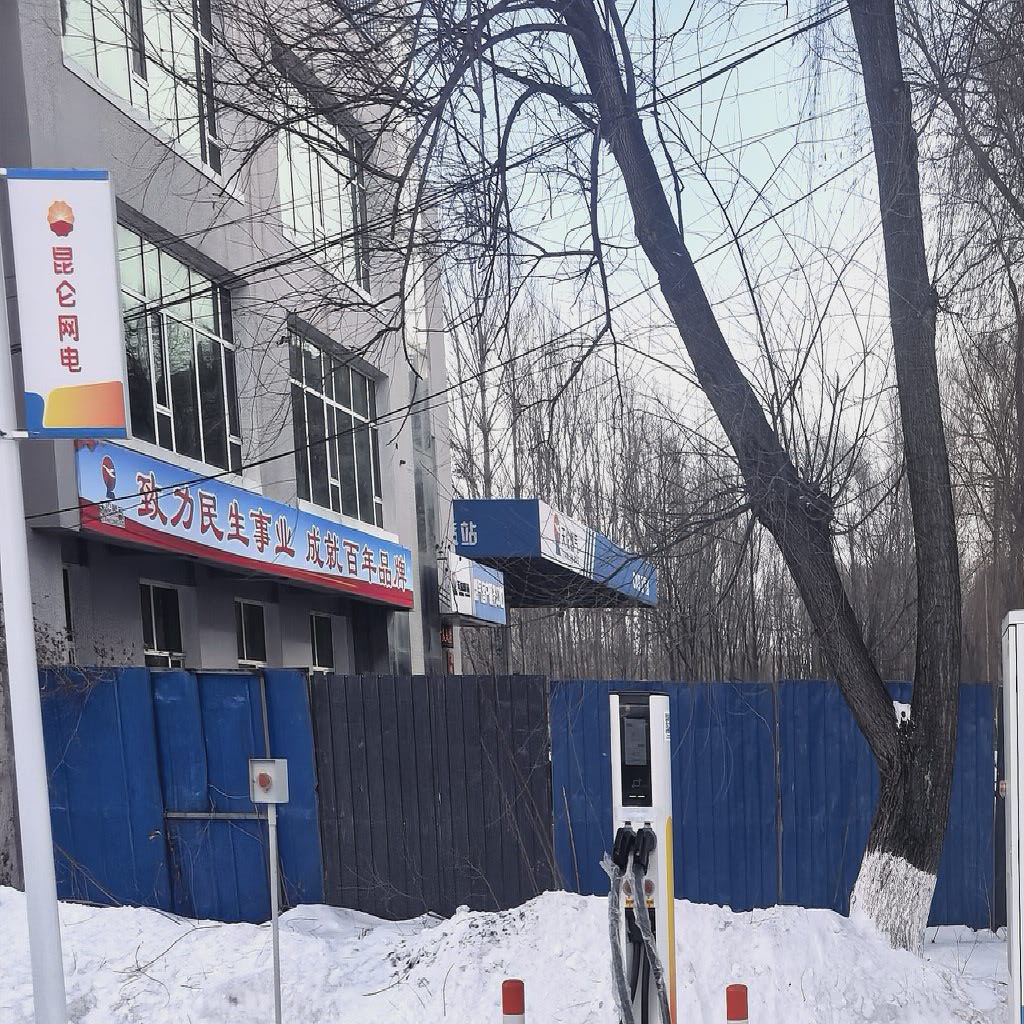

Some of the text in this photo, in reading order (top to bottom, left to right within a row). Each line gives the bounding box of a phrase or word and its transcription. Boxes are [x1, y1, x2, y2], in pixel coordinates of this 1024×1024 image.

[52, 246, 82, 374] 昆仑网电
[136, 470, 407, 592] 致力民生事业 成就百年品牌
